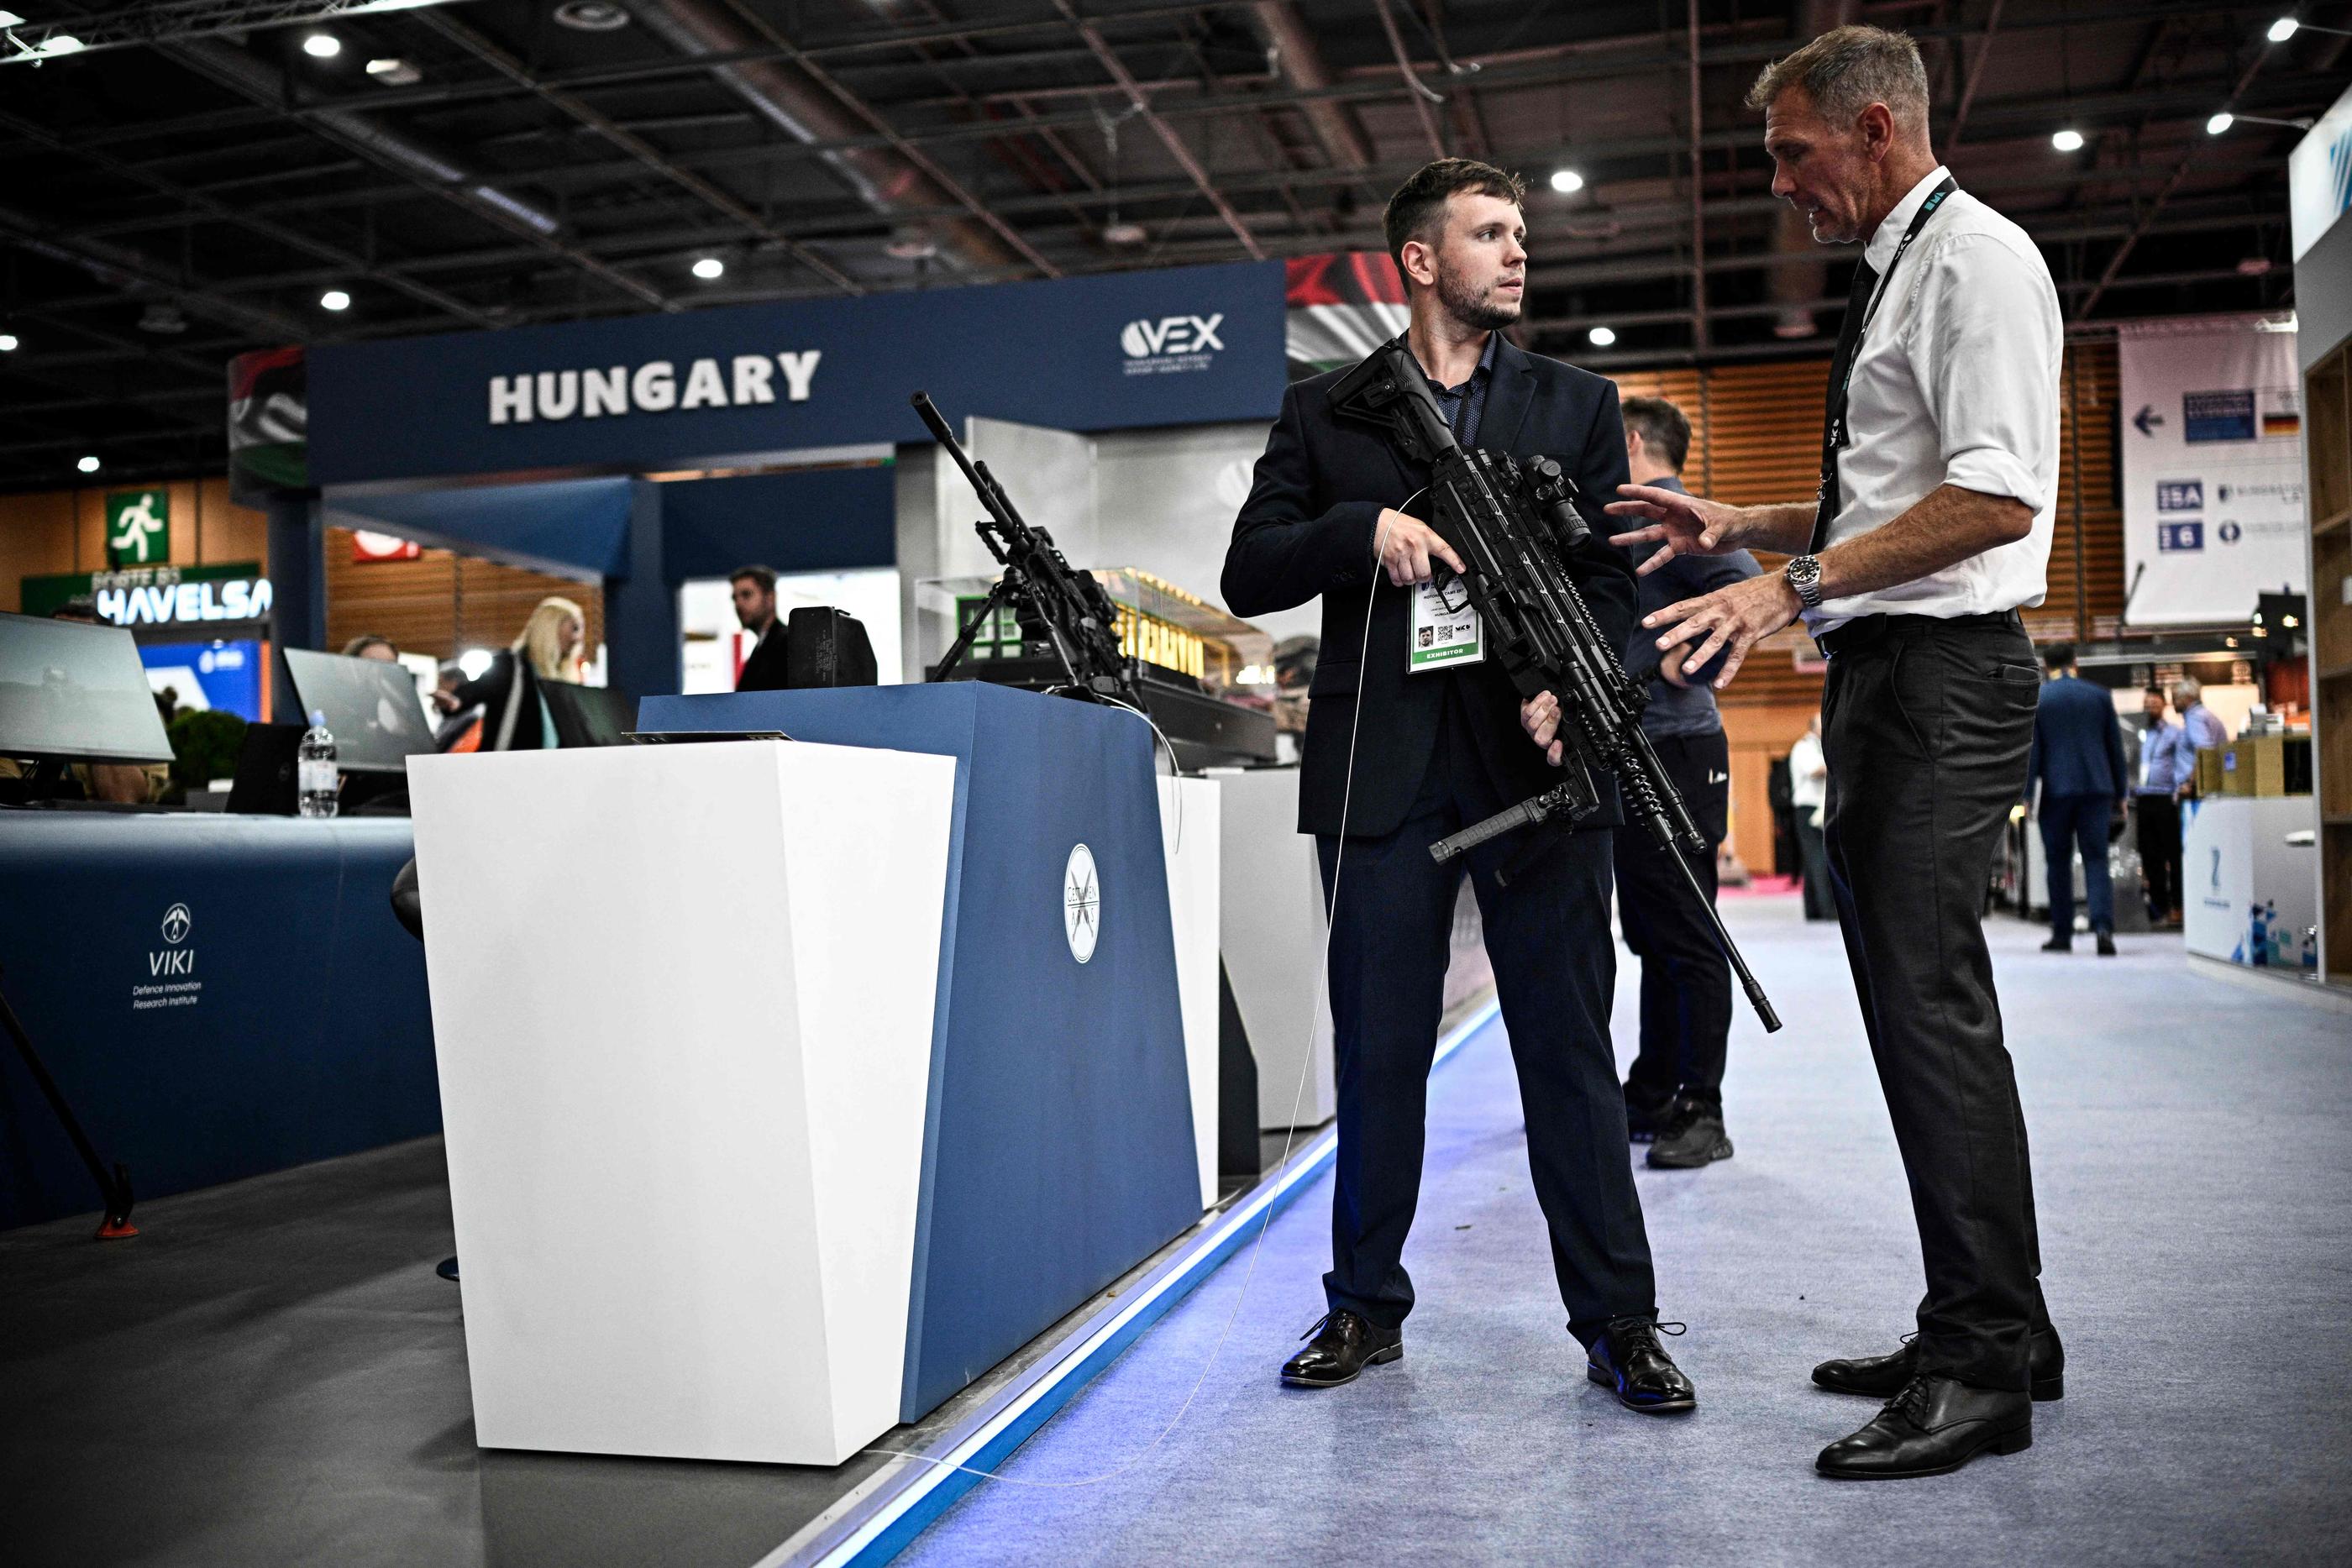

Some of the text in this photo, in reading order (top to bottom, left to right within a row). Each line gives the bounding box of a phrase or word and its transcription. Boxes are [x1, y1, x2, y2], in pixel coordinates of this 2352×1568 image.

[489, 349, 822, 424] HUNGARY
[1426, 648, 1464, 659] EXHIBITOR
[149, 949, 194, 977] VIKI
[133, 981, 202, 996] Defence Innovation
[133, 995, 197, 1009] Research Institute
